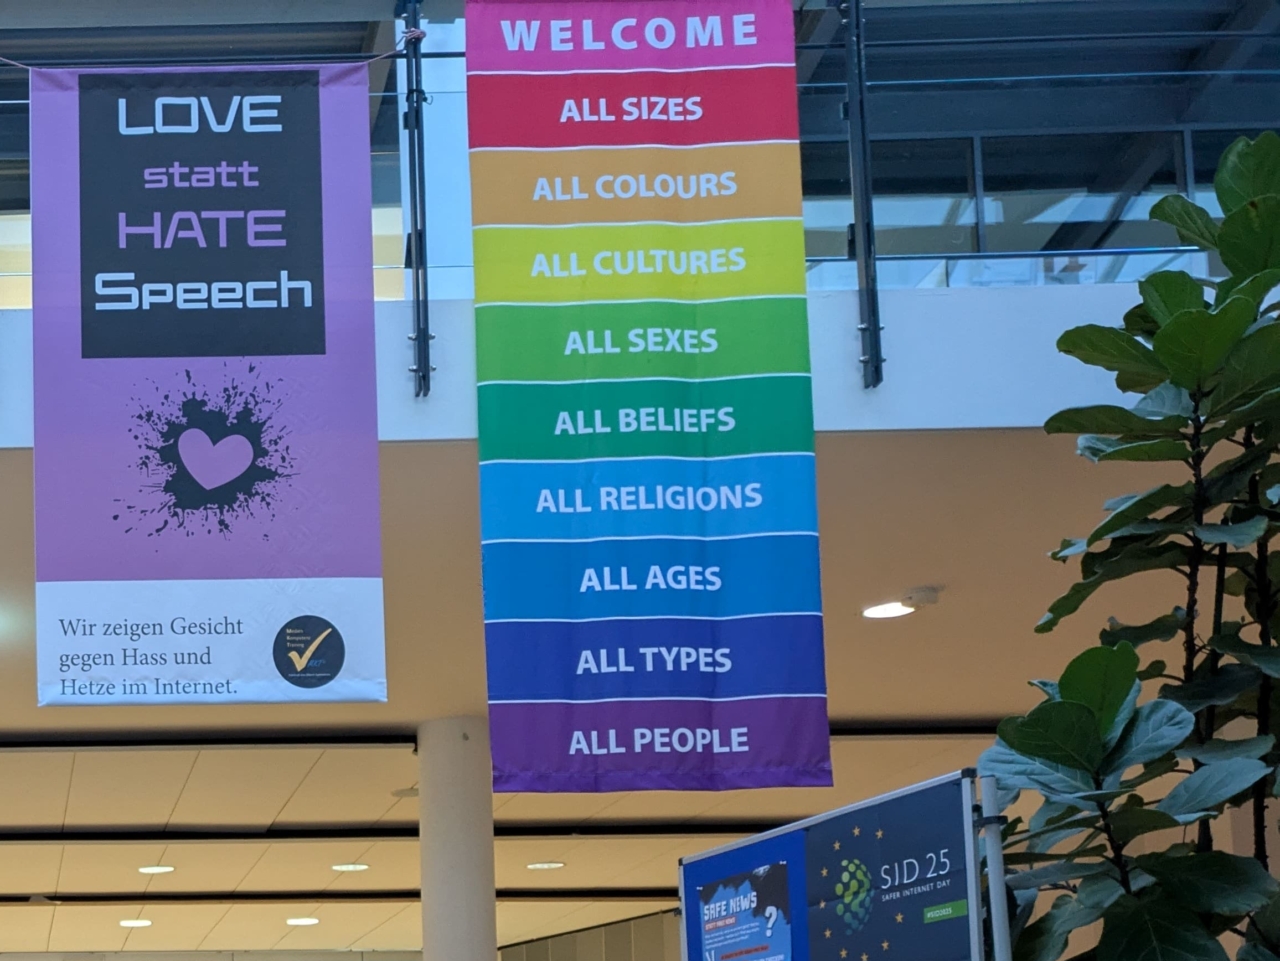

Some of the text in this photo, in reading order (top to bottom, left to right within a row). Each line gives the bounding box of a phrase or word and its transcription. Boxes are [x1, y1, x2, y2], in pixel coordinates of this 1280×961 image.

[501, 13, 757, 51] WELCOME
[118, 95, 282, 135] LOVE
[560, 96, 703, 122] ALL SIZES
[144, 161, 259, 188] statt
[532, 171, 738, 201] ALL COLOURS
[119, 210, 286, 249] HATE
[531, 248, 746, 277] ALL CULTURES
[95, 271, 312, 310] Speech
[564, 328, 718, 355] ALL SEXES
[554, 407, 736, 435] ALL BELIEFS
[536, 482, 762, 512] ALL RELIGIONS
[580, 565, 722, 592] ALL AGES
[59, 616, 243, 641] Wir zeigen Gesicht
[60, 647, 212, 672] gegen Hass und
[576, 647, 732, 674] ALL TYPES
[61, 678, 238, 695] Hetze im Internet.
[569, 727, 749, 755] ALL PEOPLE
[881, 849, 950, 889] SID 25
[882, 879, 951, 902] SAFER INTERNET DAY
[704, 892, 757, 920] SAFE NEWS
